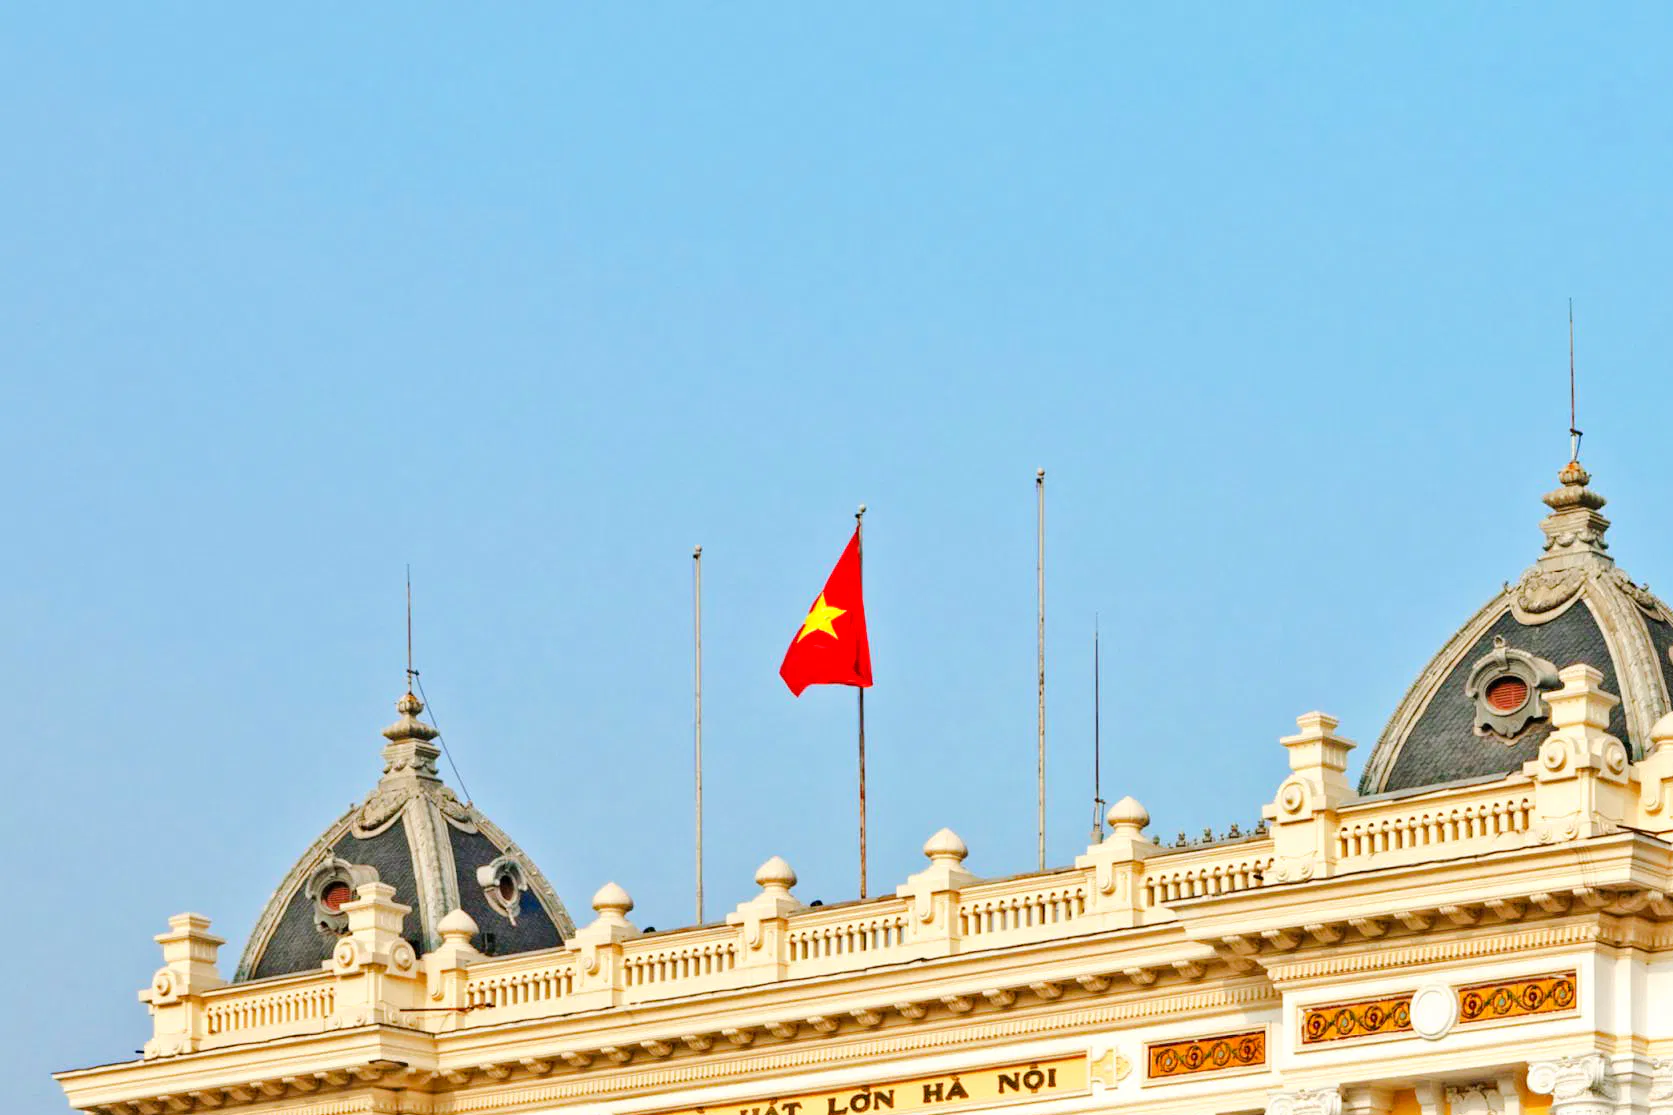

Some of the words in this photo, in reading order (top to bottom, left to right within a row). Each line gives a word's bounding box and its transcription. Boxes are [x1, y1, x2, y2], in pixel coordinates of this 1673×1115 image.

[827, 1085, 894, 1115] LỚN
[923, 1073, 969, 1104] HÀ
[998, 1063, 1057, 1094] NỘI
